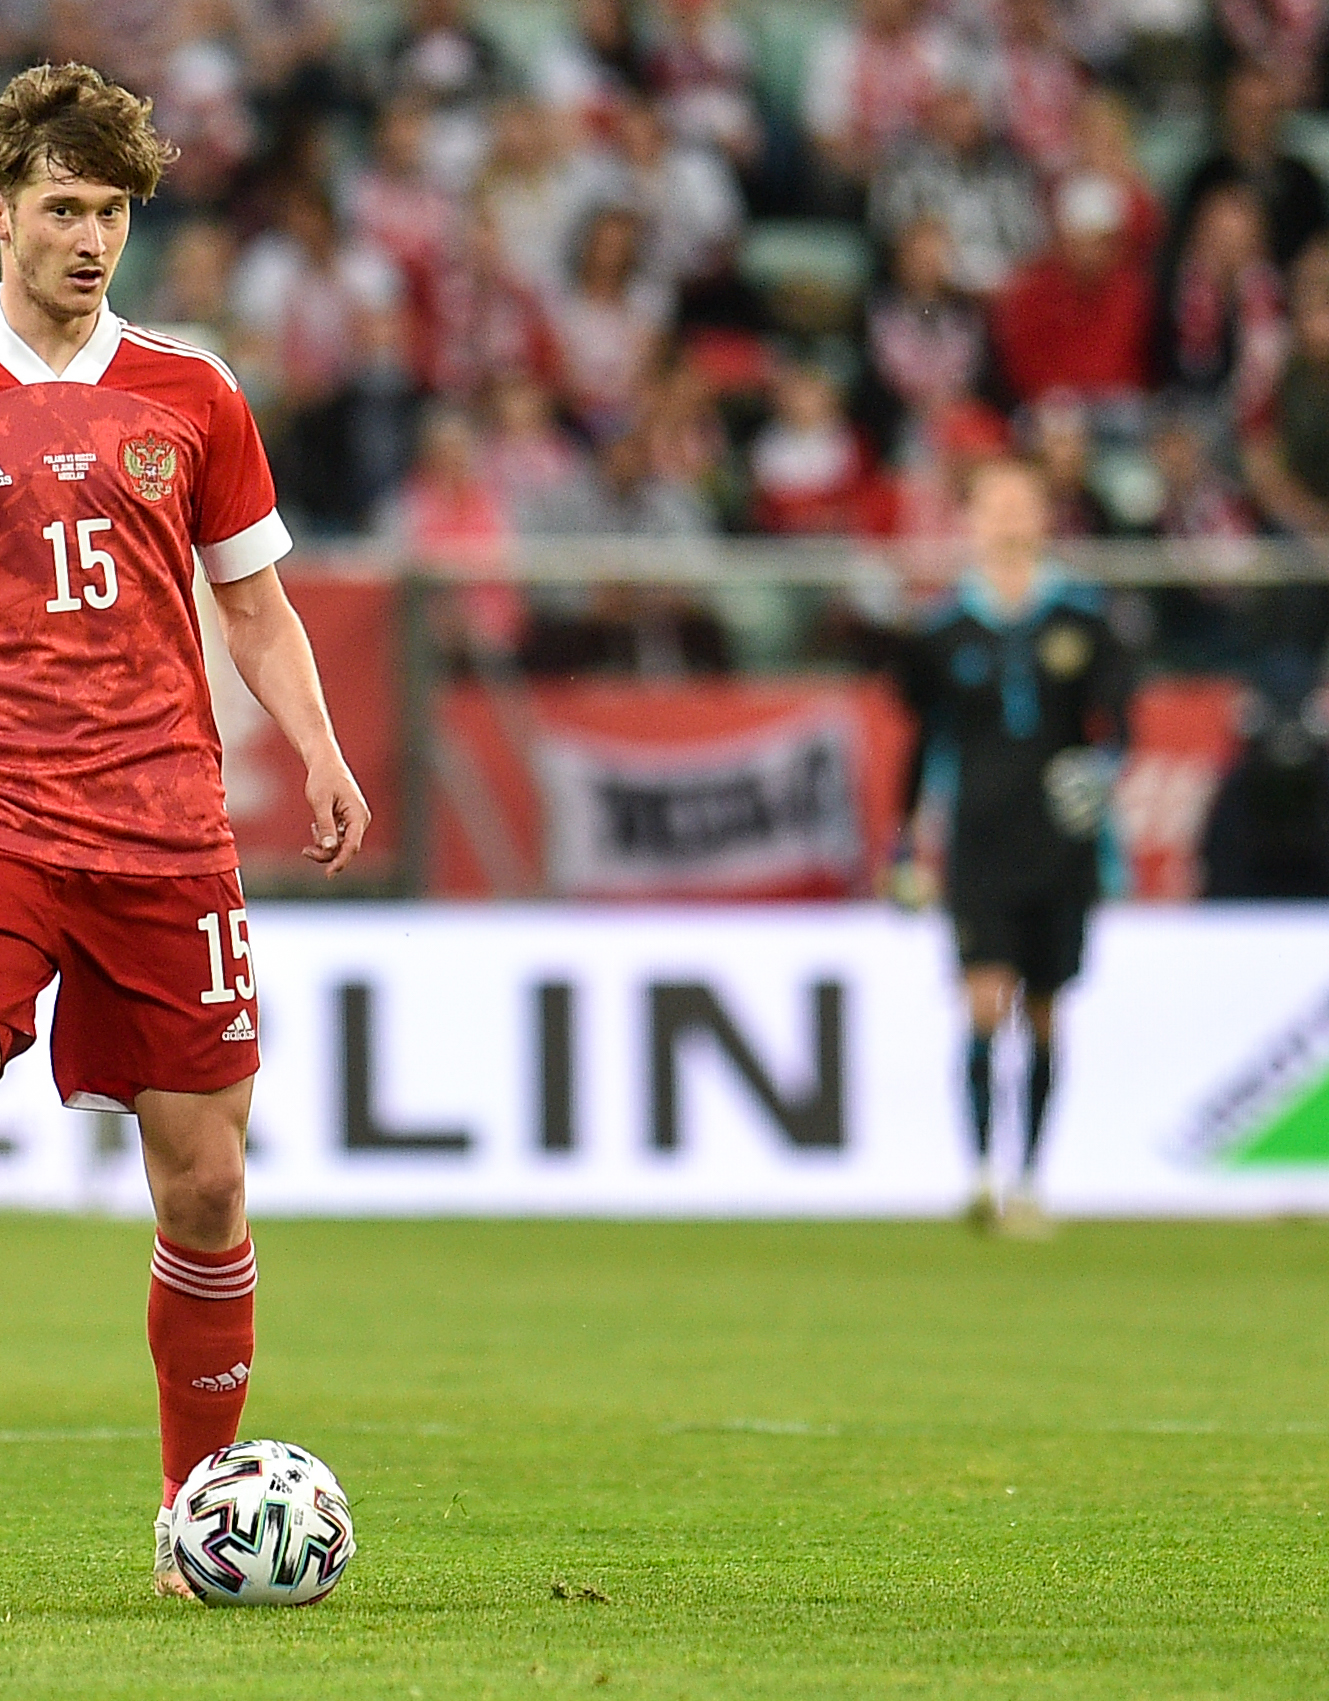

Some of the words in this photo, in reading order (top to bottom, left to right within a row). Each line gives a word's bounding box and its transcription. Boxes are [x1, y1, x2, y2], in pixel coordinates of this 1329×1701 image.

[43, 518, 119, 613] 15
[197, 909, 255, 1004] 15
[222, 1029, 256, 1041] adidas
